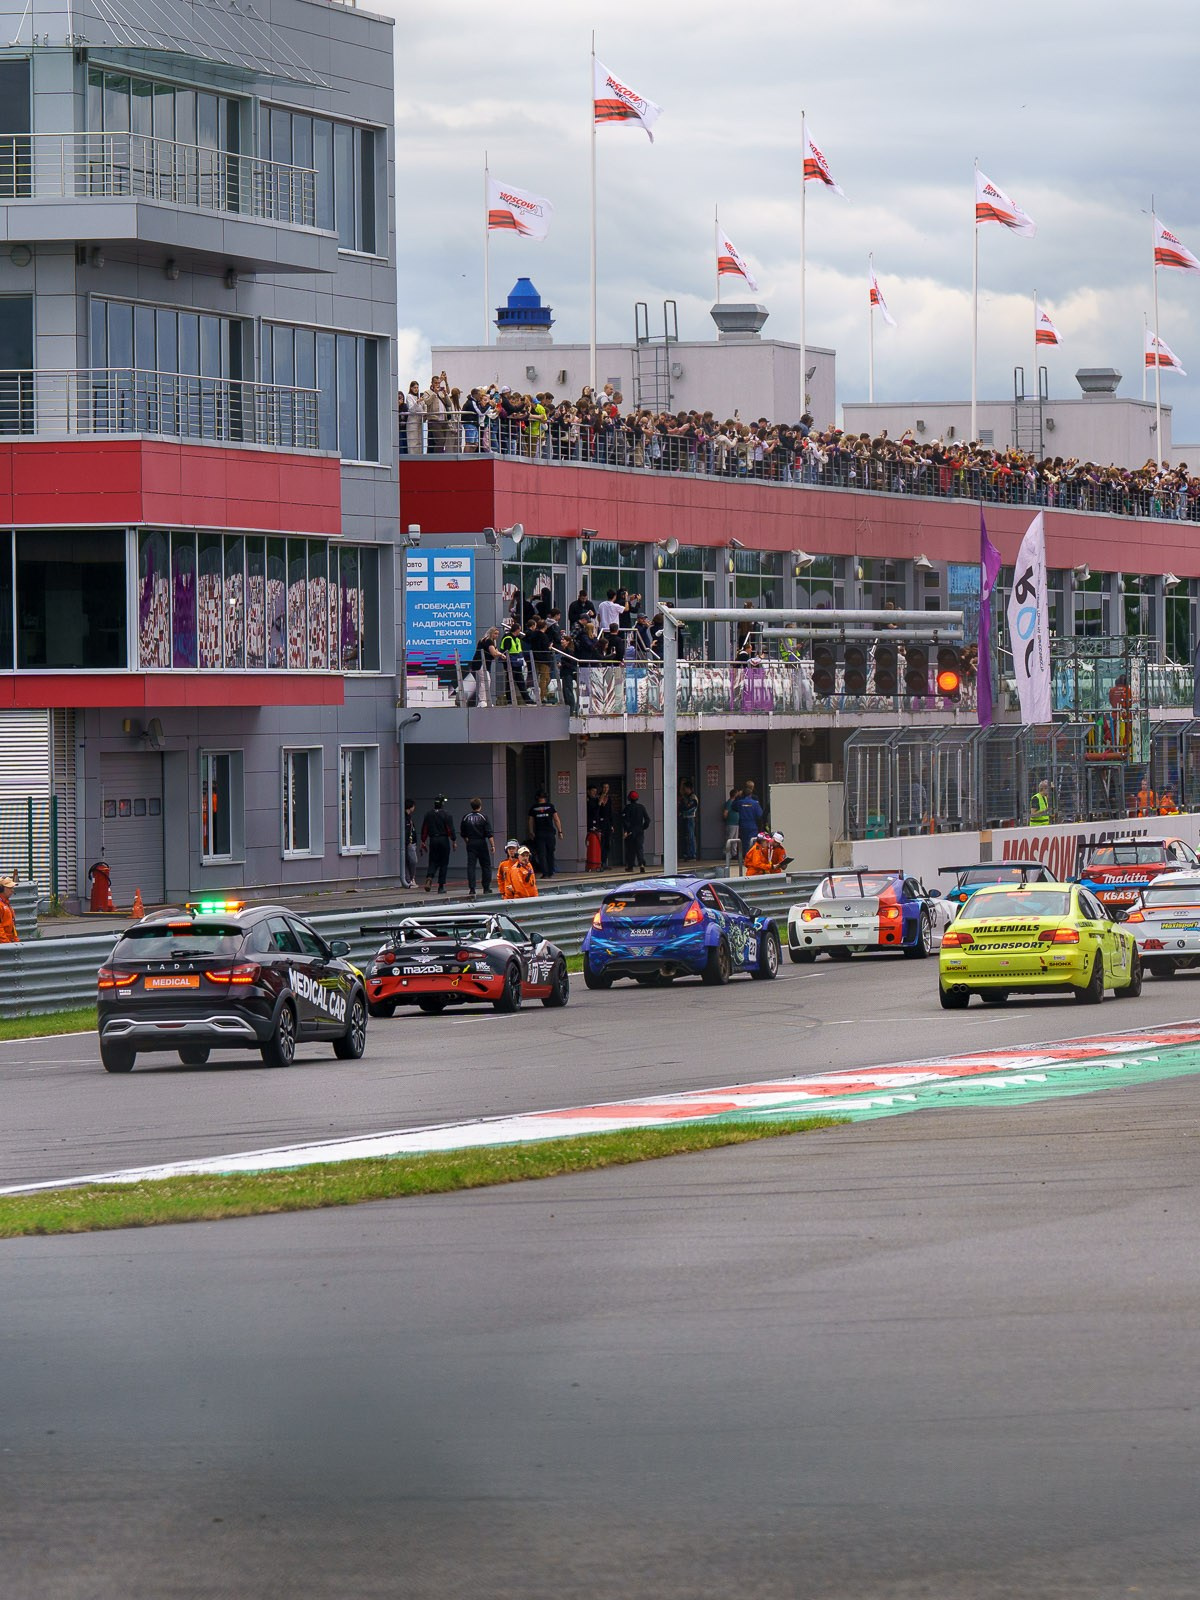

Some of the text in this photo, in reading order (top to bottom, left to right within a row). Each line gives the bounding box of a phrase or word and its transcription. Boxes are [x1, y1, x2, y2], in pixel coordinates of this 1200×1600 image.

[414, 602, 471, 610] «ПОБЕЖДАЕТ
[432, 611, 471, 619] ТАКТИКА,
[412, 620, 471, 628] НАДЕЖНОСТЬ
[434, 629, 472, 637] ТЕХНИКИ
[1102, 872, 1149, 885] makita
[606, 901, 627, 913] 23
[972, 924, 1041, 934] MILLENIALS
[968, 941, 1045, 951] MOTORSPORT
[146, 963, 194, 971] LADA
[152, 978, 191, 986] MEDICAL
[288, 967, 347, 1023] MEDICAL CAR
